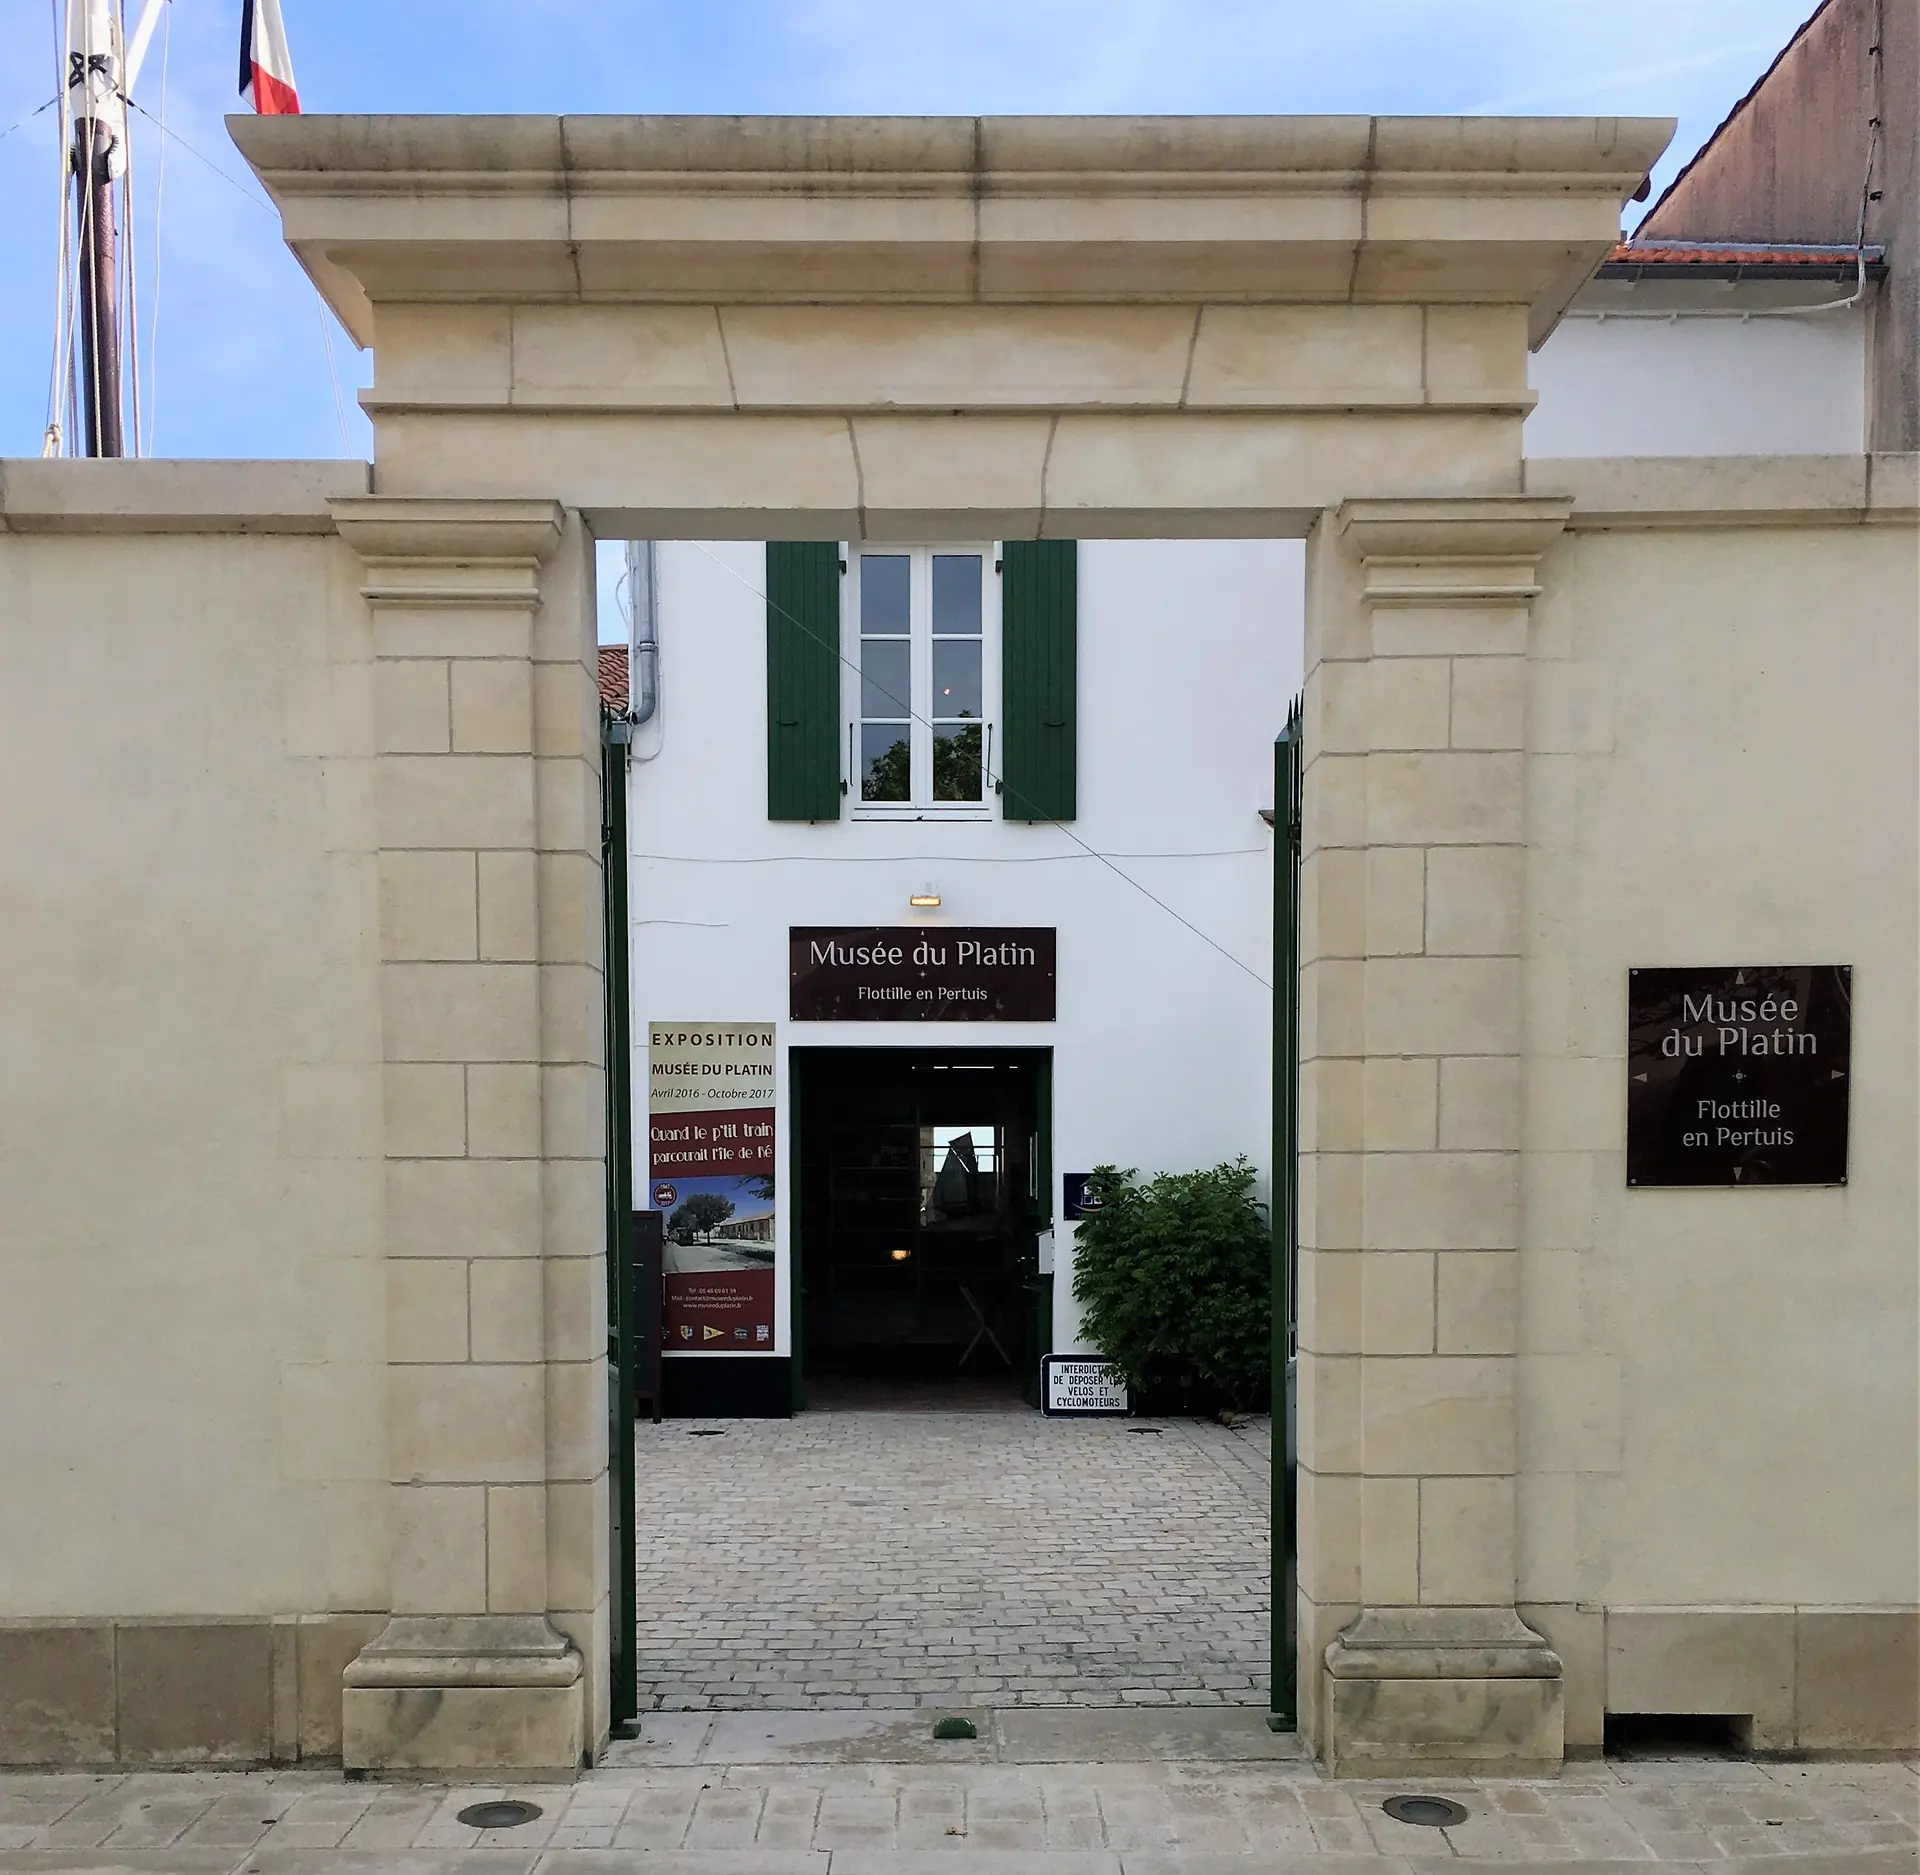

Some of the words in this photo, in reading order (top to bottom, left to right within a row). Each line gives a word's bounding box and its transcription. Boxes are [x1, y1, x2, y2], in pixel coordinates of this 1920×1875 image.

[810, 940, 903, 966] Musée
[912, 940, 946, 966] du
[956, 940, 1035, 966] Platin
[858, 986, 914, 1000] Flottille
[916, 990, 933, 1000] en
[937, 986, 988, 1000] Pertuis
[1683, 993, 1798, 1024] Musée
[652, 1033, 772, 1046] EXPOSITION
[1661, 1028, 1703, 1057] du
[1717, 1027, 1817, 1056] Platin
[652, 1062, 699, 1075] MUSÉE
[702, 1064, 721, 1075] DU
[725, 1064, 773, 1075] PLATIN
[650, 1088, 674, 1099] Avril
[675, 1088, 700, 1099] 2016
[707, 1088, 748, 1099] Octobre
[748, 1088, 774, 1099] 2017
[1697, 1099, 1781, 1119] Flottille
[650, 1126, 690, 1142] Quand
[694, 1125, 708, 1140] le
[712, 1123, 738, 1142] p'tit
[743, 1122, 774, 1138] train
[1682, 1131, 1708, 1147] en
[1716, 1127, 1794, 1146] Pertuis
[653, 1147, 709, 1166] parcourait
[738, 1146, 753, 1160] de
[1053, 1375, 1064, 1385] DE
[1099, 1386, 1109, 1396] ET
[1056, 1397, 1120, 1407] CYCLOMOTEURS
